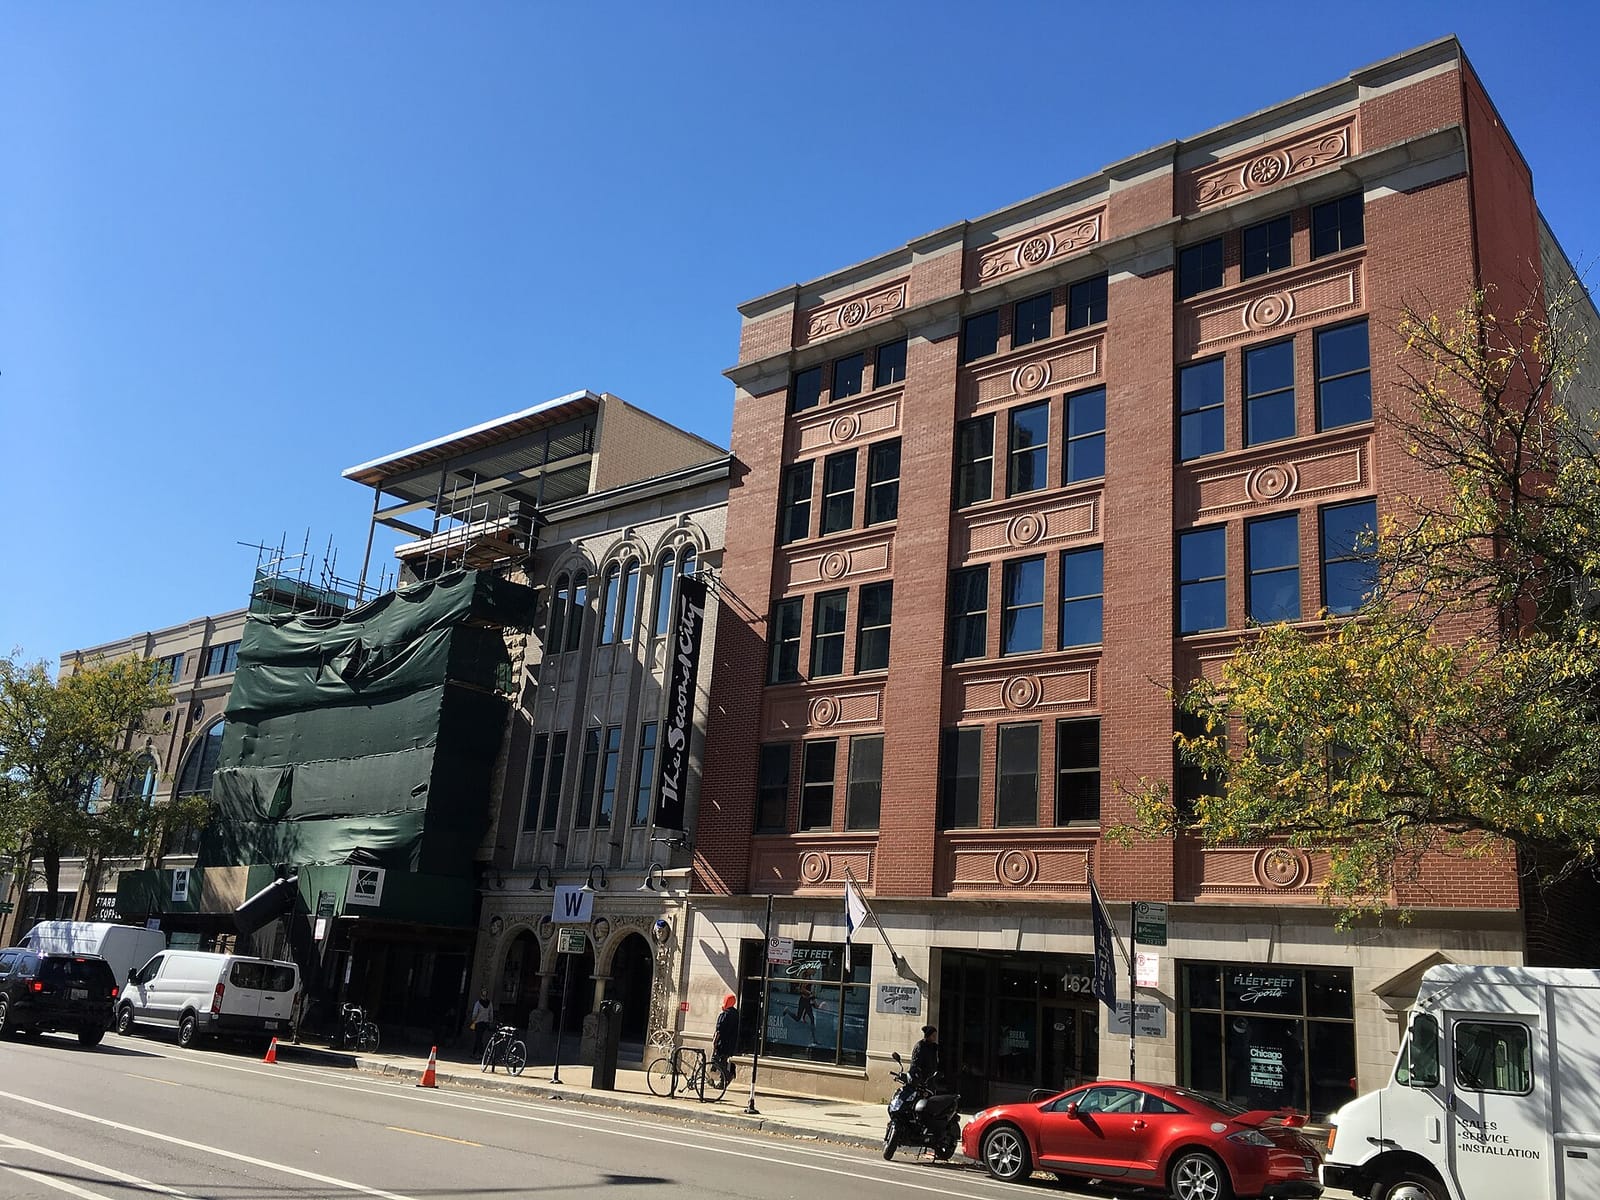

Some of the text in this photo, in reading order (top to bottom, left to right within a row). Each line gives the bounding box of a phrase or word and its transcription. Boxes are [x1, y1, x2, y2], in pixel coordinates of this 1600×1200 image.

[661, 594, 704, 808] The Second City
[565, 892, 584, 917] W
[810, 948, 834, 959] FEET
[785, 958, 825, 976] Sports
[1233, 976, 1295, 988] FLEET FEET
[1240, 986, 1286, 1003] Sports
[1250, 1048, 1283, 1060] Chicago
[1250, 1076, 1284, 1087] Marathon
[1462, 1119, 1498, 1131] SALES
[1462, 1131, 1510, 1144] SERVICE
[1462, 1143, 1540, 1160] INSTALLATION
